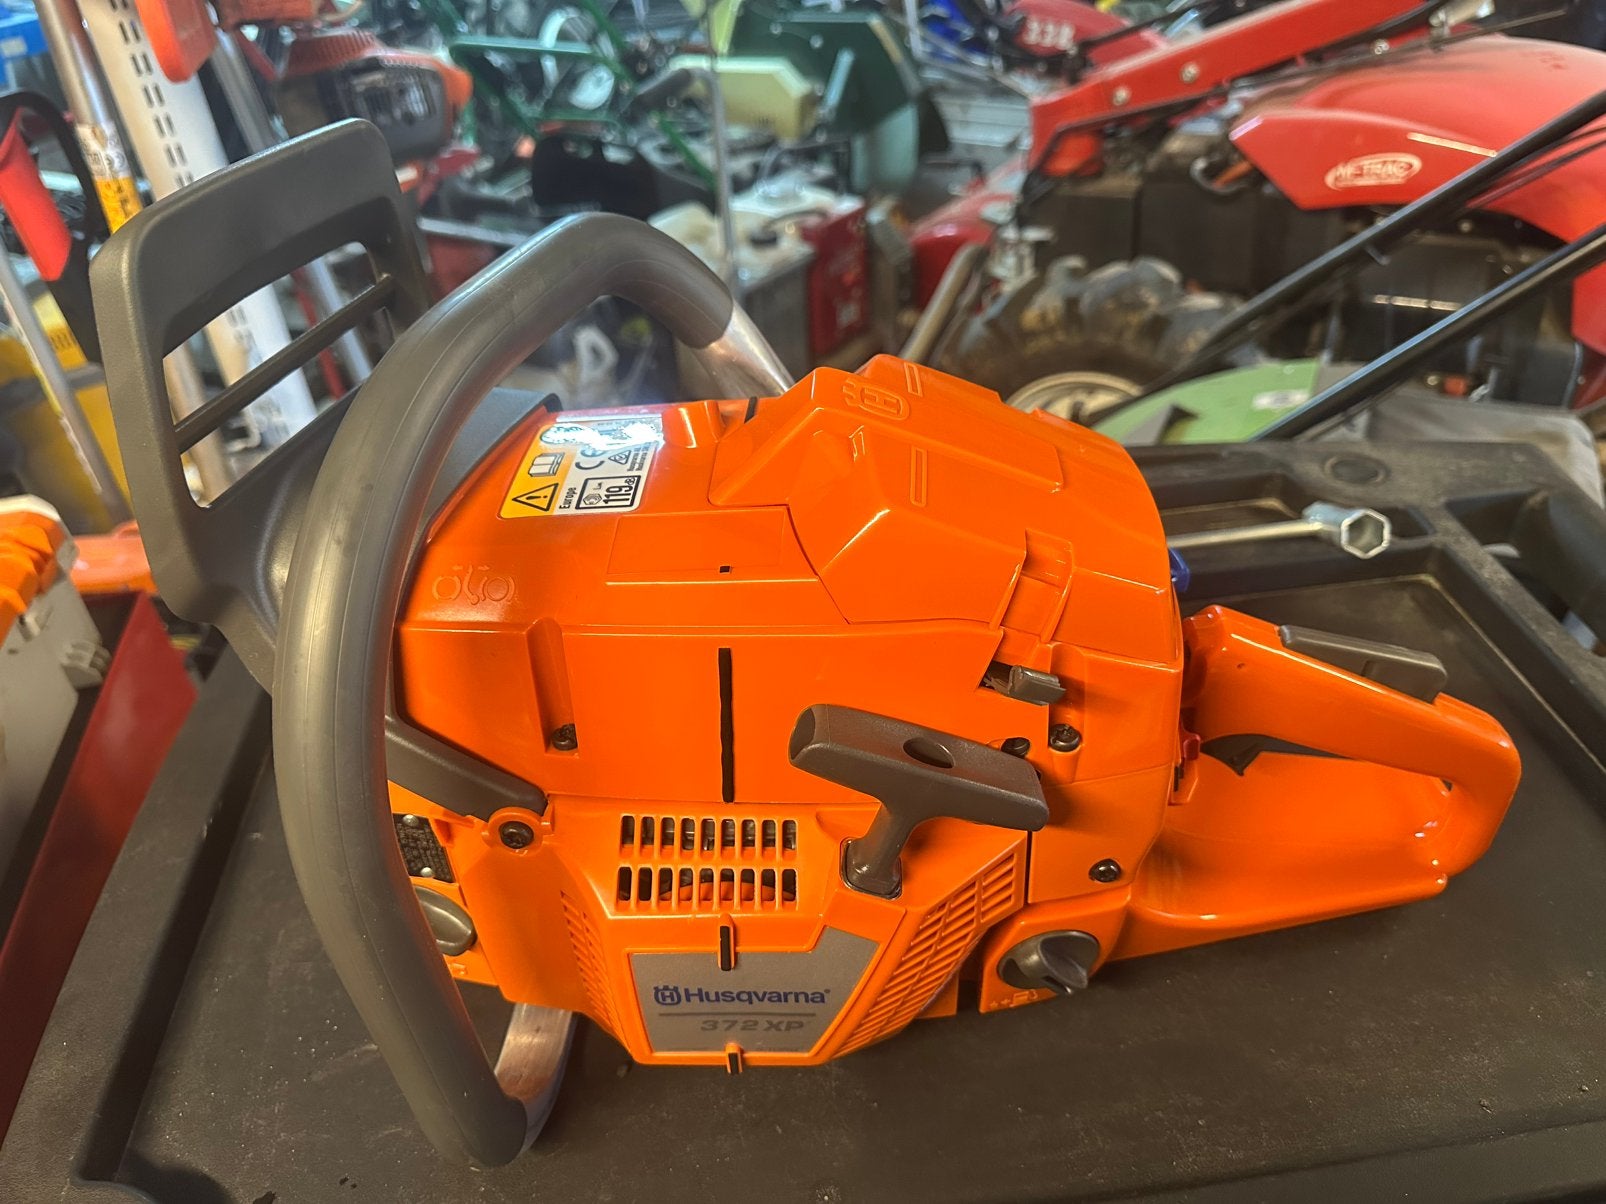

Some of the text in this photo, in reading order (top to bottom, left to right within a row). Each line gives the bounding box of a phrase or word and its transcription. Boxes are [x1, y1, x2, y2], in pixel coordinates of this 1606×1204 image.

[558, 487, 577, 509] Europe
[602, 485, 634, 505] 119
[685, 987, 827, 1005] Husqvarna
[701, 1020, 805, 1032] 372 XP
